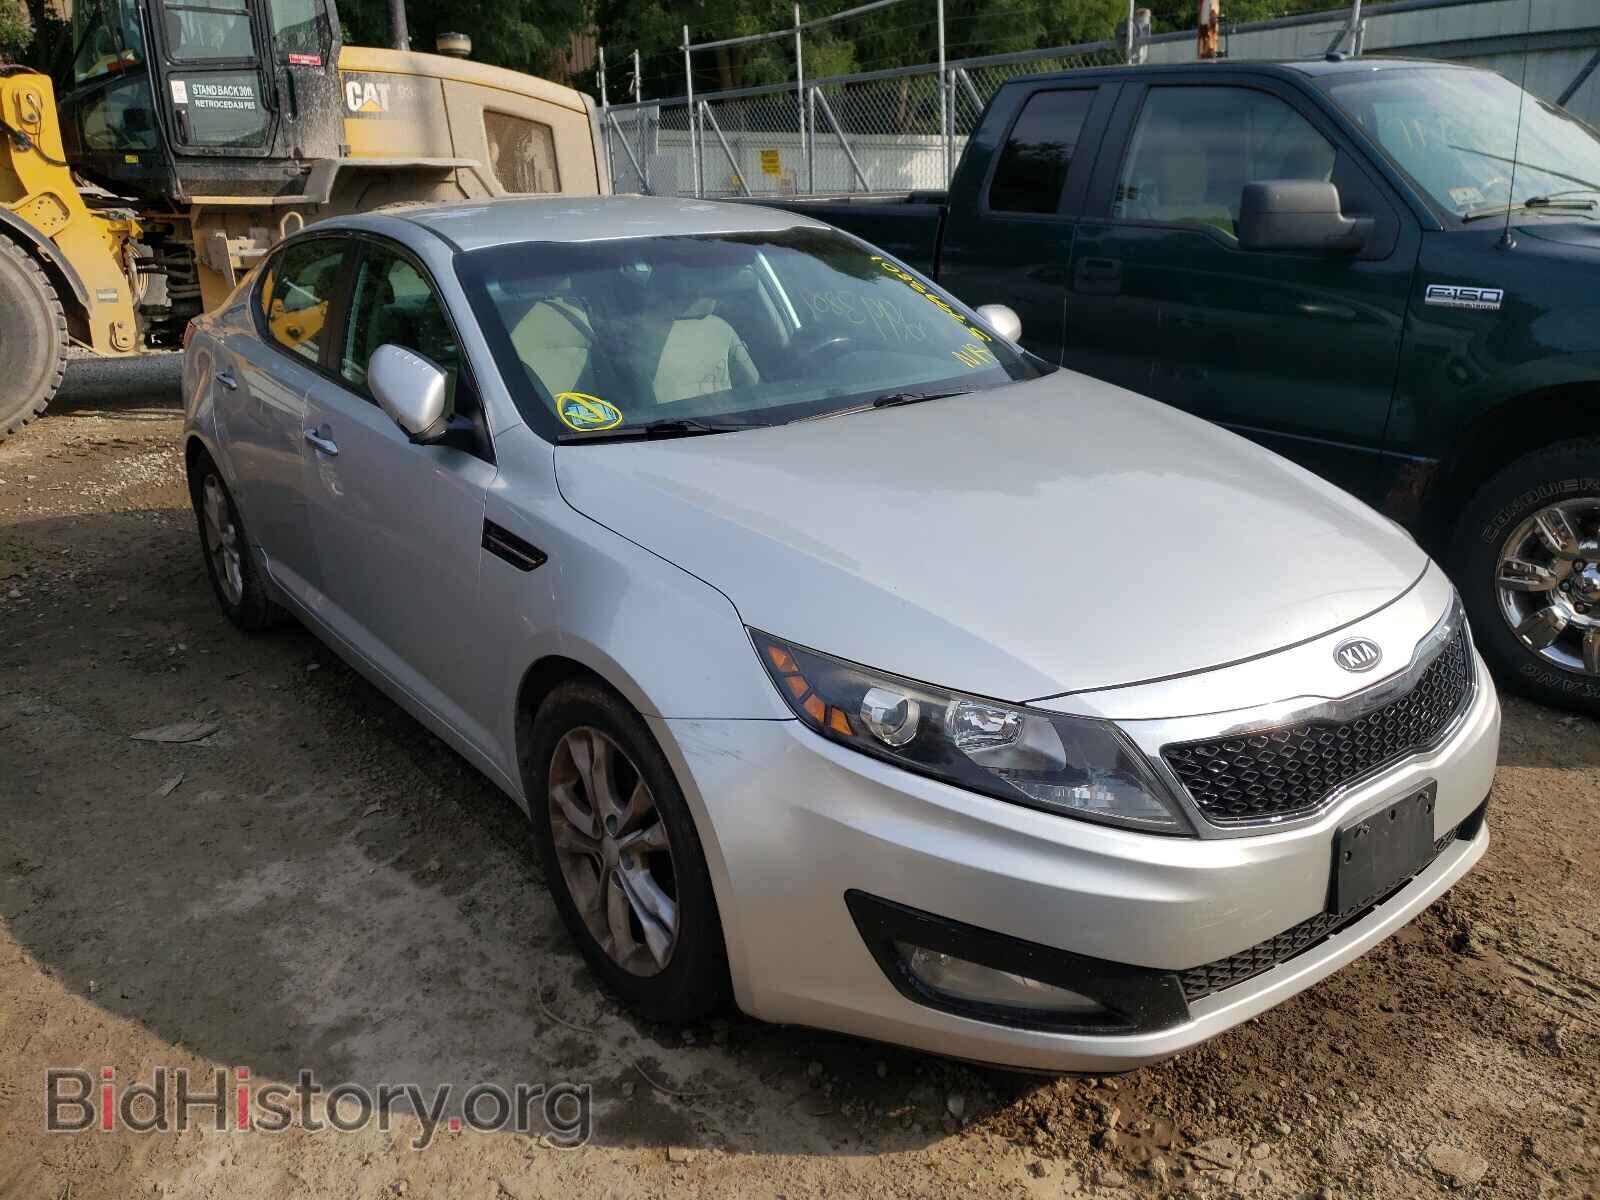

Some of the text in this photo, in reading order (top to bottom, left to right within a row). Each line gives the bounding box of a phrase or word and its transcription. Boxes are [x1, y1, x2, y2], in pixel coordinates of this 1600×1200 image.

[192, 84, 217, 96] STAND
[218, 86, 239, 97] BACK
[345, 81, 390, 112] CAT
[1340, 642, 1378, 667] KIA
